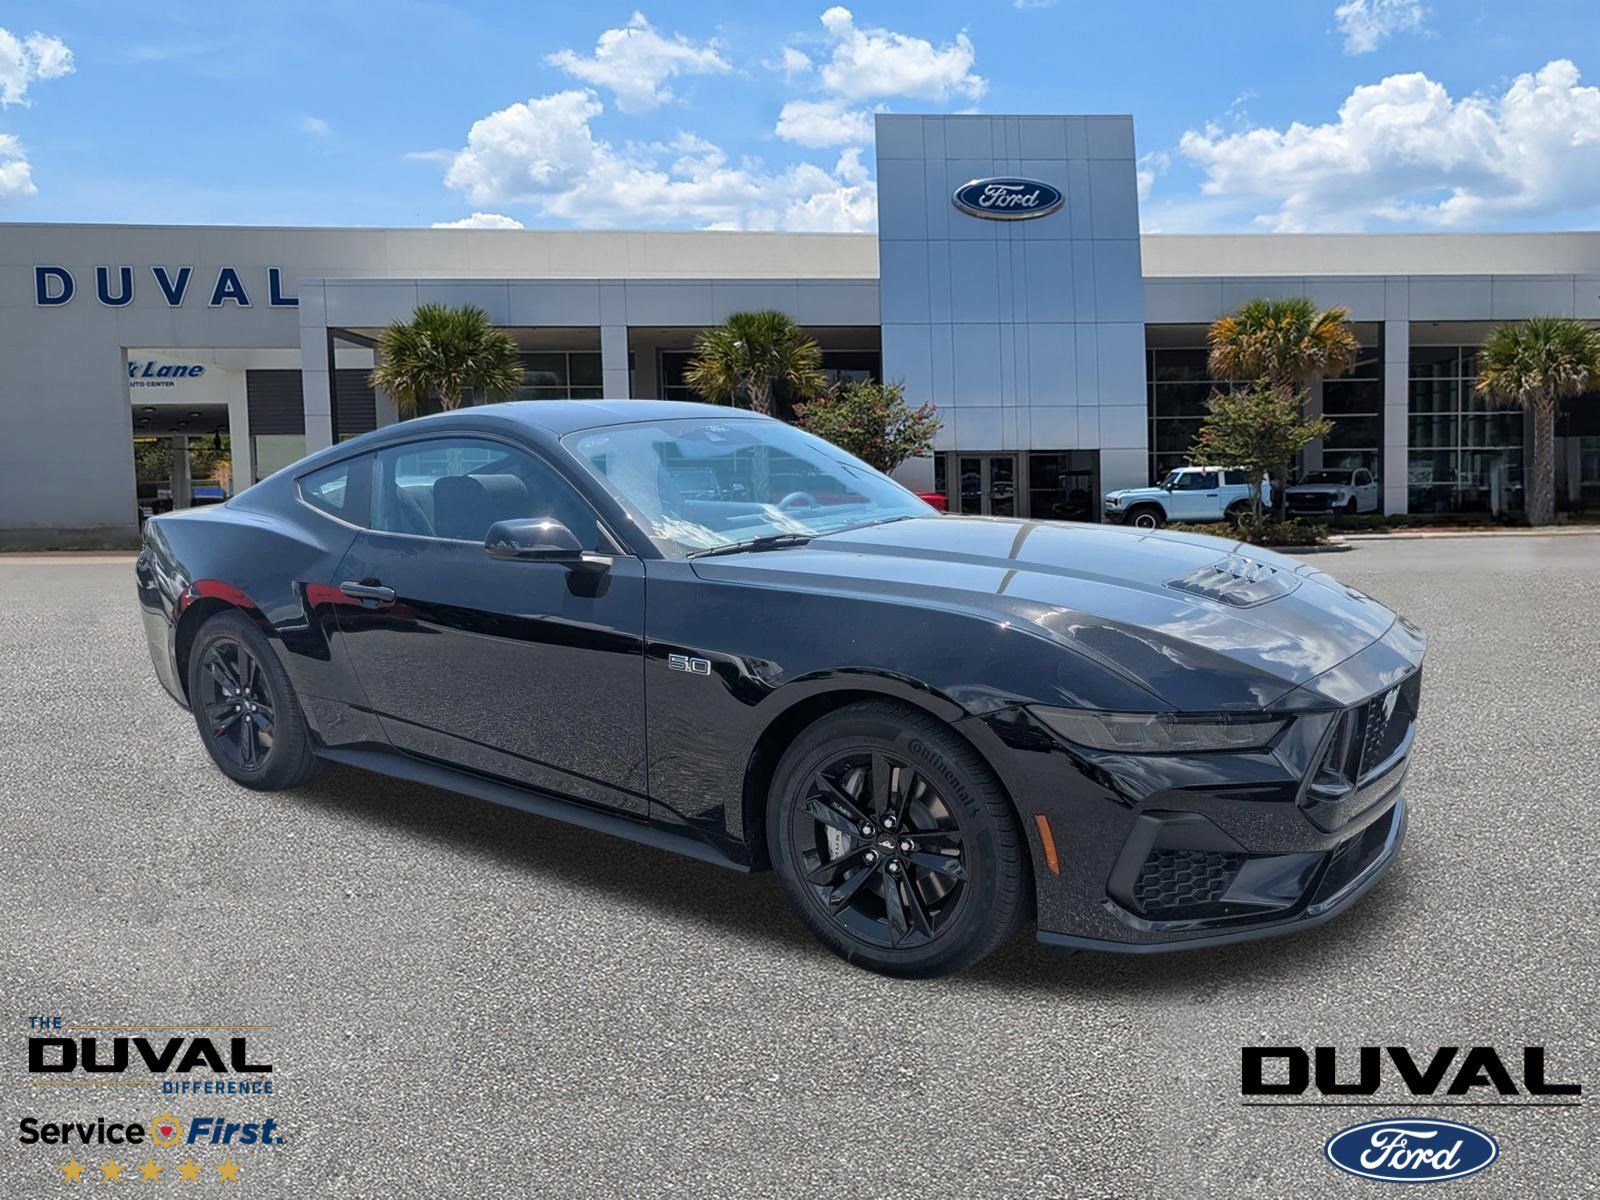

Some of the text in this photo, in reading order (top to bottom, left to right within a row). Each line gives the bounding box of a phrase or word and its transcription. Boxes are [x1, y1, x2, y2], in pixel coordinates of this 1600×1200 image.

[978, 184, 1040, 207] Ford
[33, 265, 299, 308] DUVAL
[142, 361, 206, 378] Lane
[669, 653, 711, 676] 5.0
[908, 739, 975, 807] Continental
